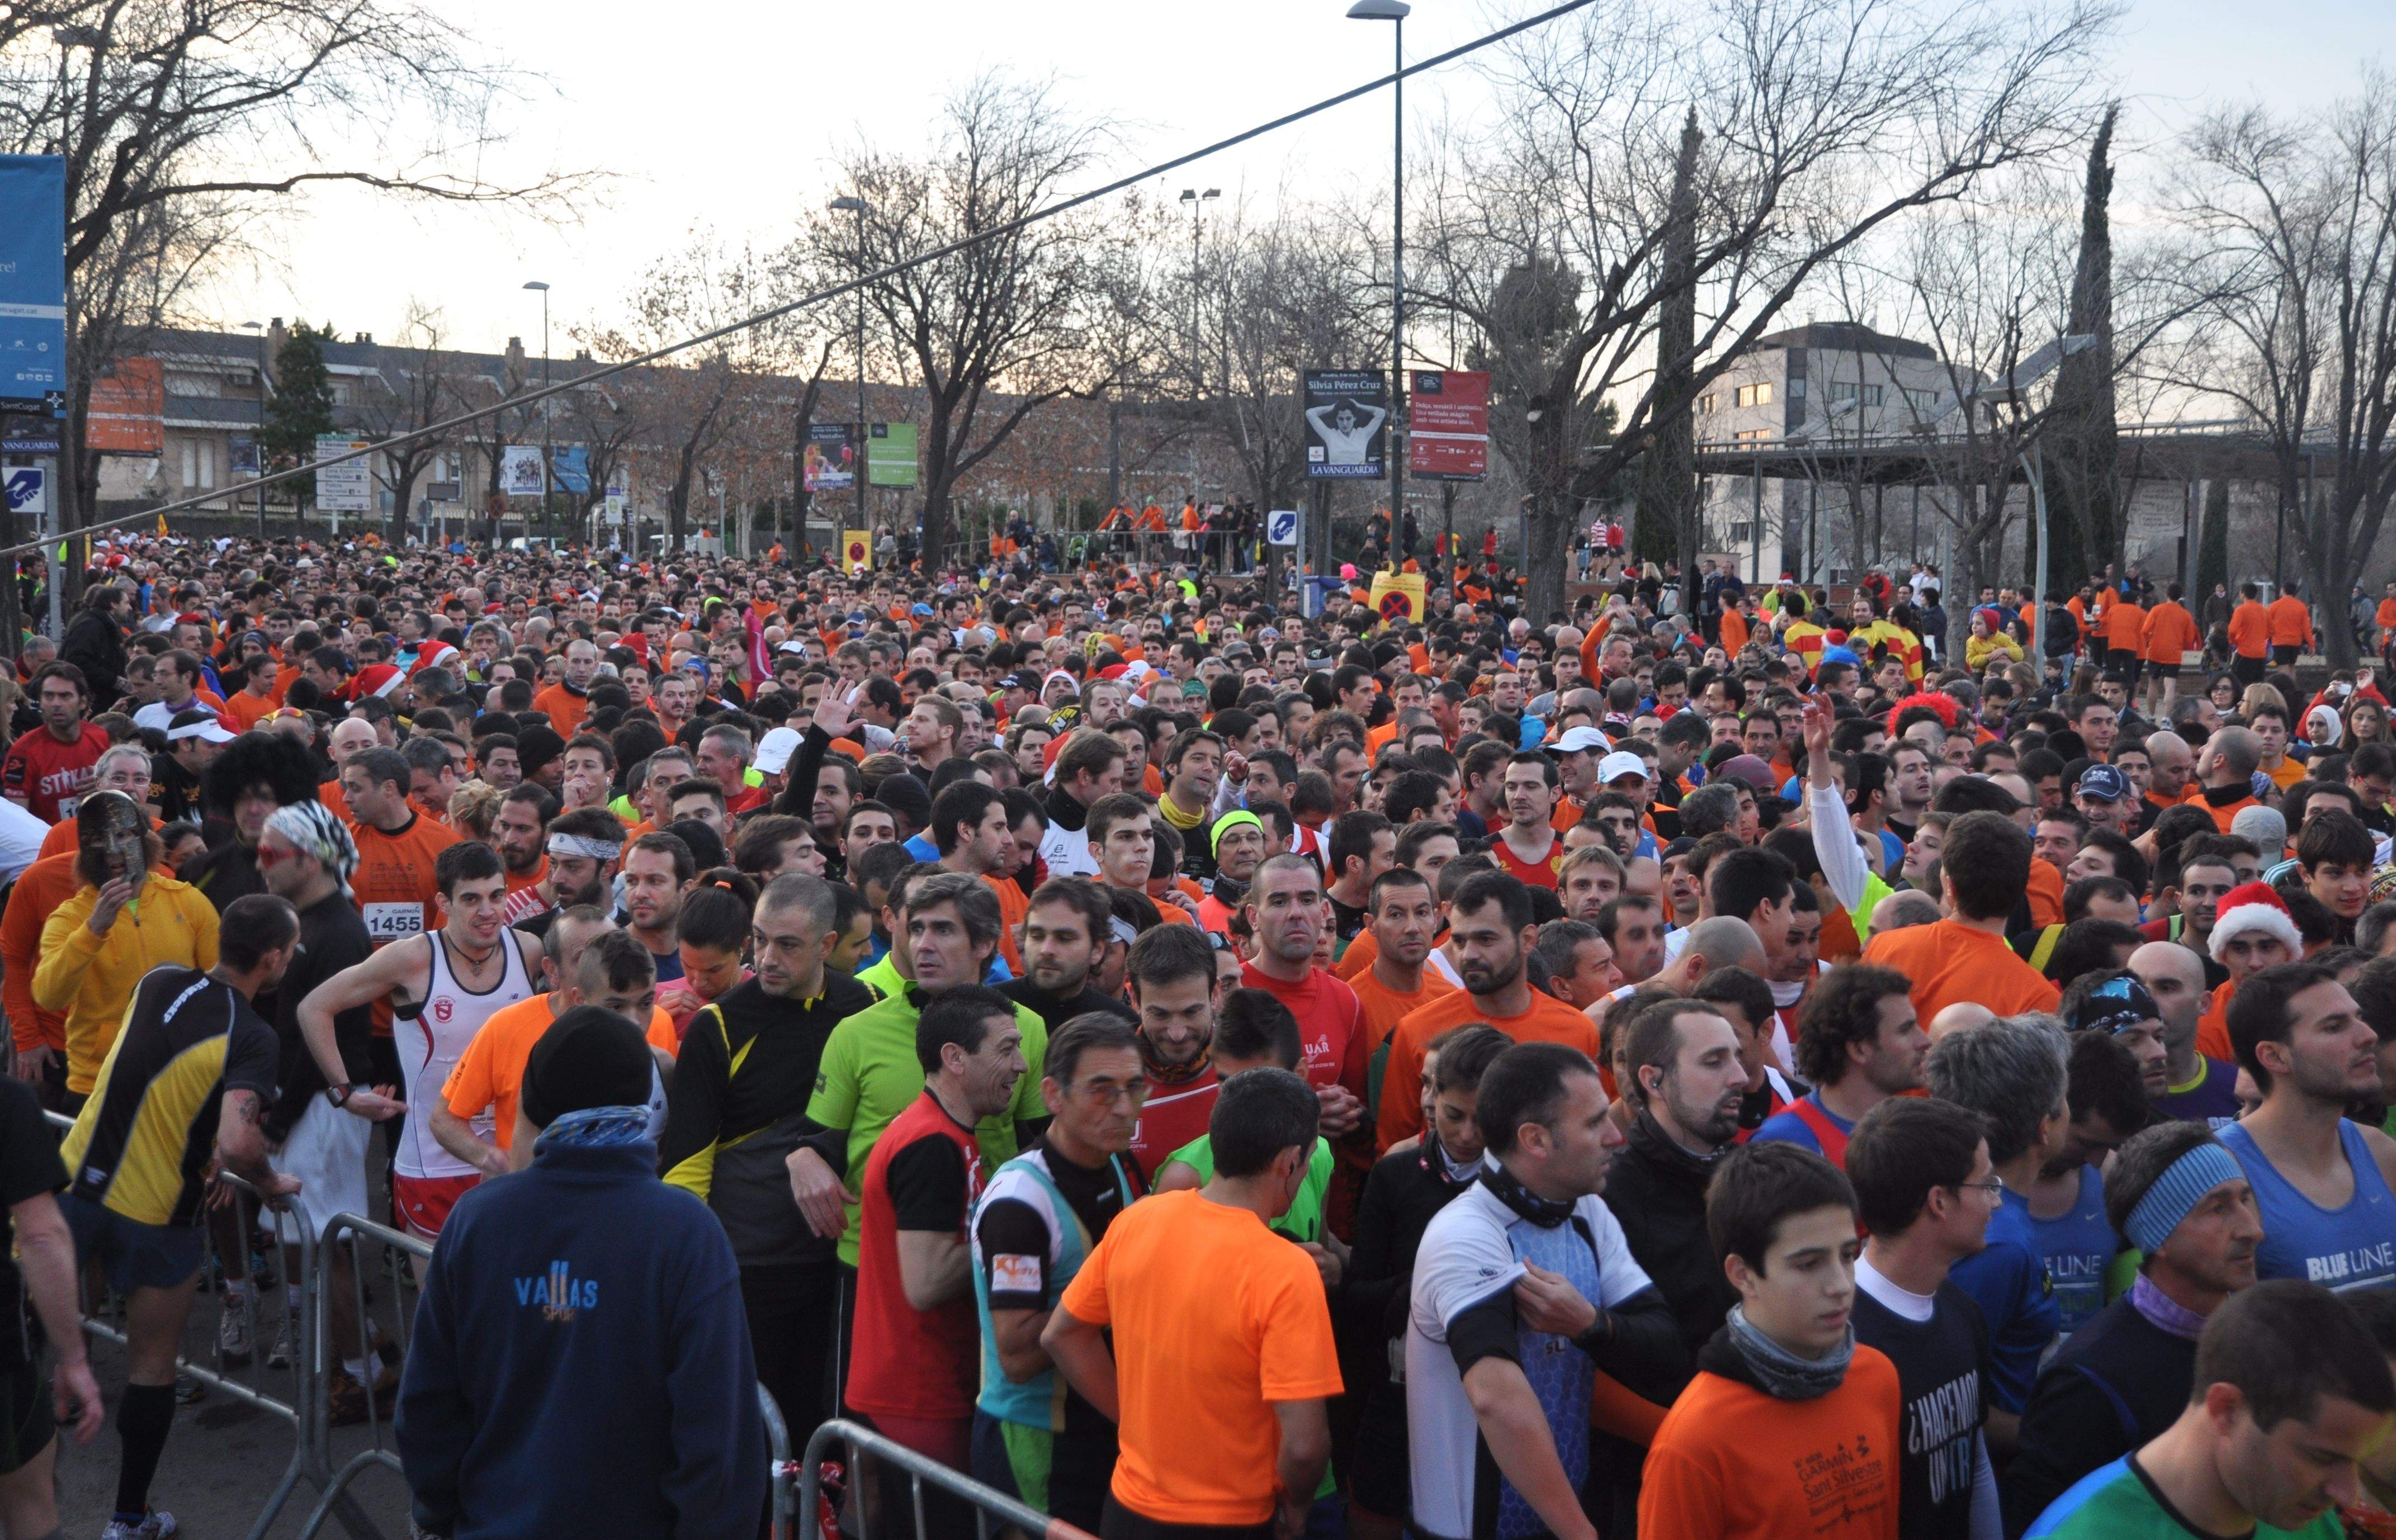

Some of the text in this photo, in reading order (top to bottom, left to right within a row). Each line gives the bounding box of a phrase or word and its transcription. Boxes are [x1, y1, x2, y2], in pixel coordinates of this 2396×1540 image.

[1308, 380, 1381, 389] Silvia Pérez Cruz
[3, 441, 60, 449] VANGUARDIA
[1323, 465, 1379, 474] VANGUARDIA
[370, 917, 421, 932] 1455
[1305, 1043, 1330, 1054] UAR
[2057, 1255, 2101, 1276] LINE
[2305, 1242, 2395, 1281] BLUE LINE
[1799, 1452, 1854, 1481] GARMIN
